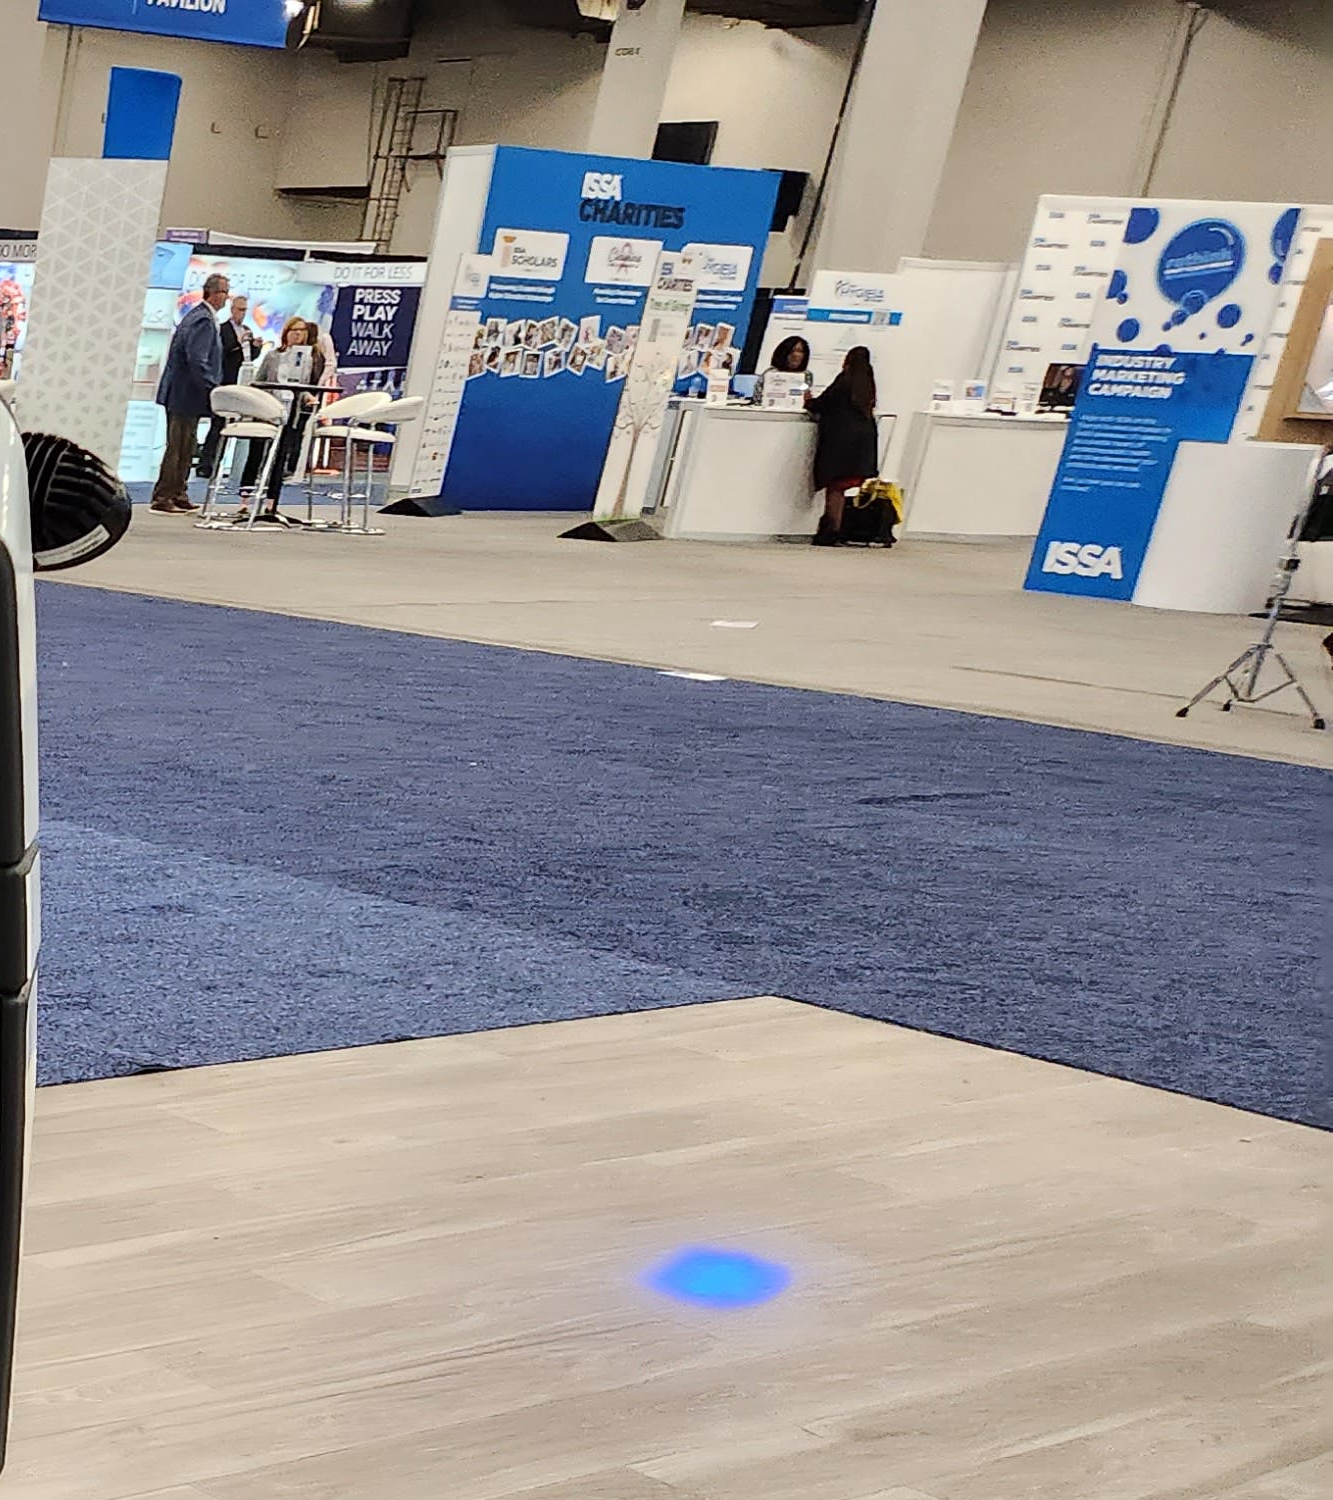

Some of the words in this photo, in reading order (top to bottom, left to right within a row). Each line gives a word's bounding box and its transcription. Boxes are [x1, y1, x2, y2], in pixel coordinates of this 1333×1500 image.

[581, 171, 624, 200] ISSA
[579, 199, 686, 229] CHARITIES
[334, 267, 351, 279] DO
[365, 267, 385, 279] FOR
[388, 267, 412, 279] LESS
[354, 288, 401, 304] PRESS
[352, 305, 398, 321] PLAY
[351, 322, 394, 339] WALK
[347, 341, 392, 356] AWAY
[1095, 355, 1177, 370] INDUSTRY
[1092, 369, 1186, 385] MARKETING
[1088, 382, 1173, 400] CAMPAIGN
[1042, 541, 1124, 579] ISSA
